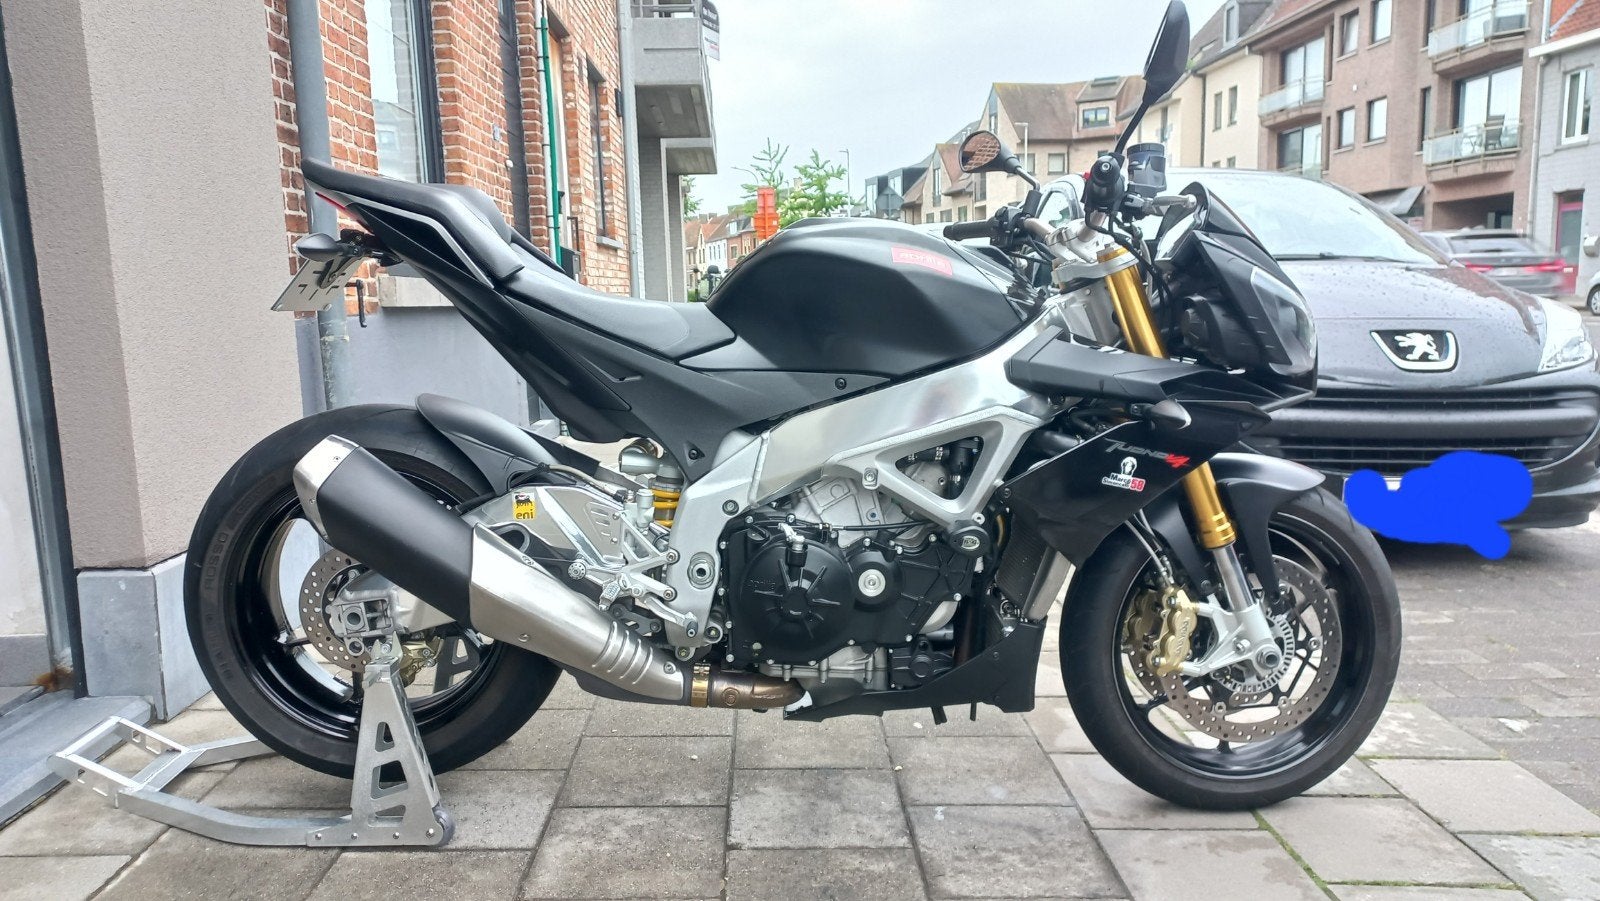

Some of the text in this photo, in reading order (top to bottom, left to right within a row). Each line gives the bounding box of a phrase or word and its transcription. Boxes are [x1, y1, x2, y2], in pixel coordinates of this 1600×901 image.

[1110, 473, 1131, 485] Marco
[1130, 478, 1145, 491] 58
[515, 508, 534, 520] eni
